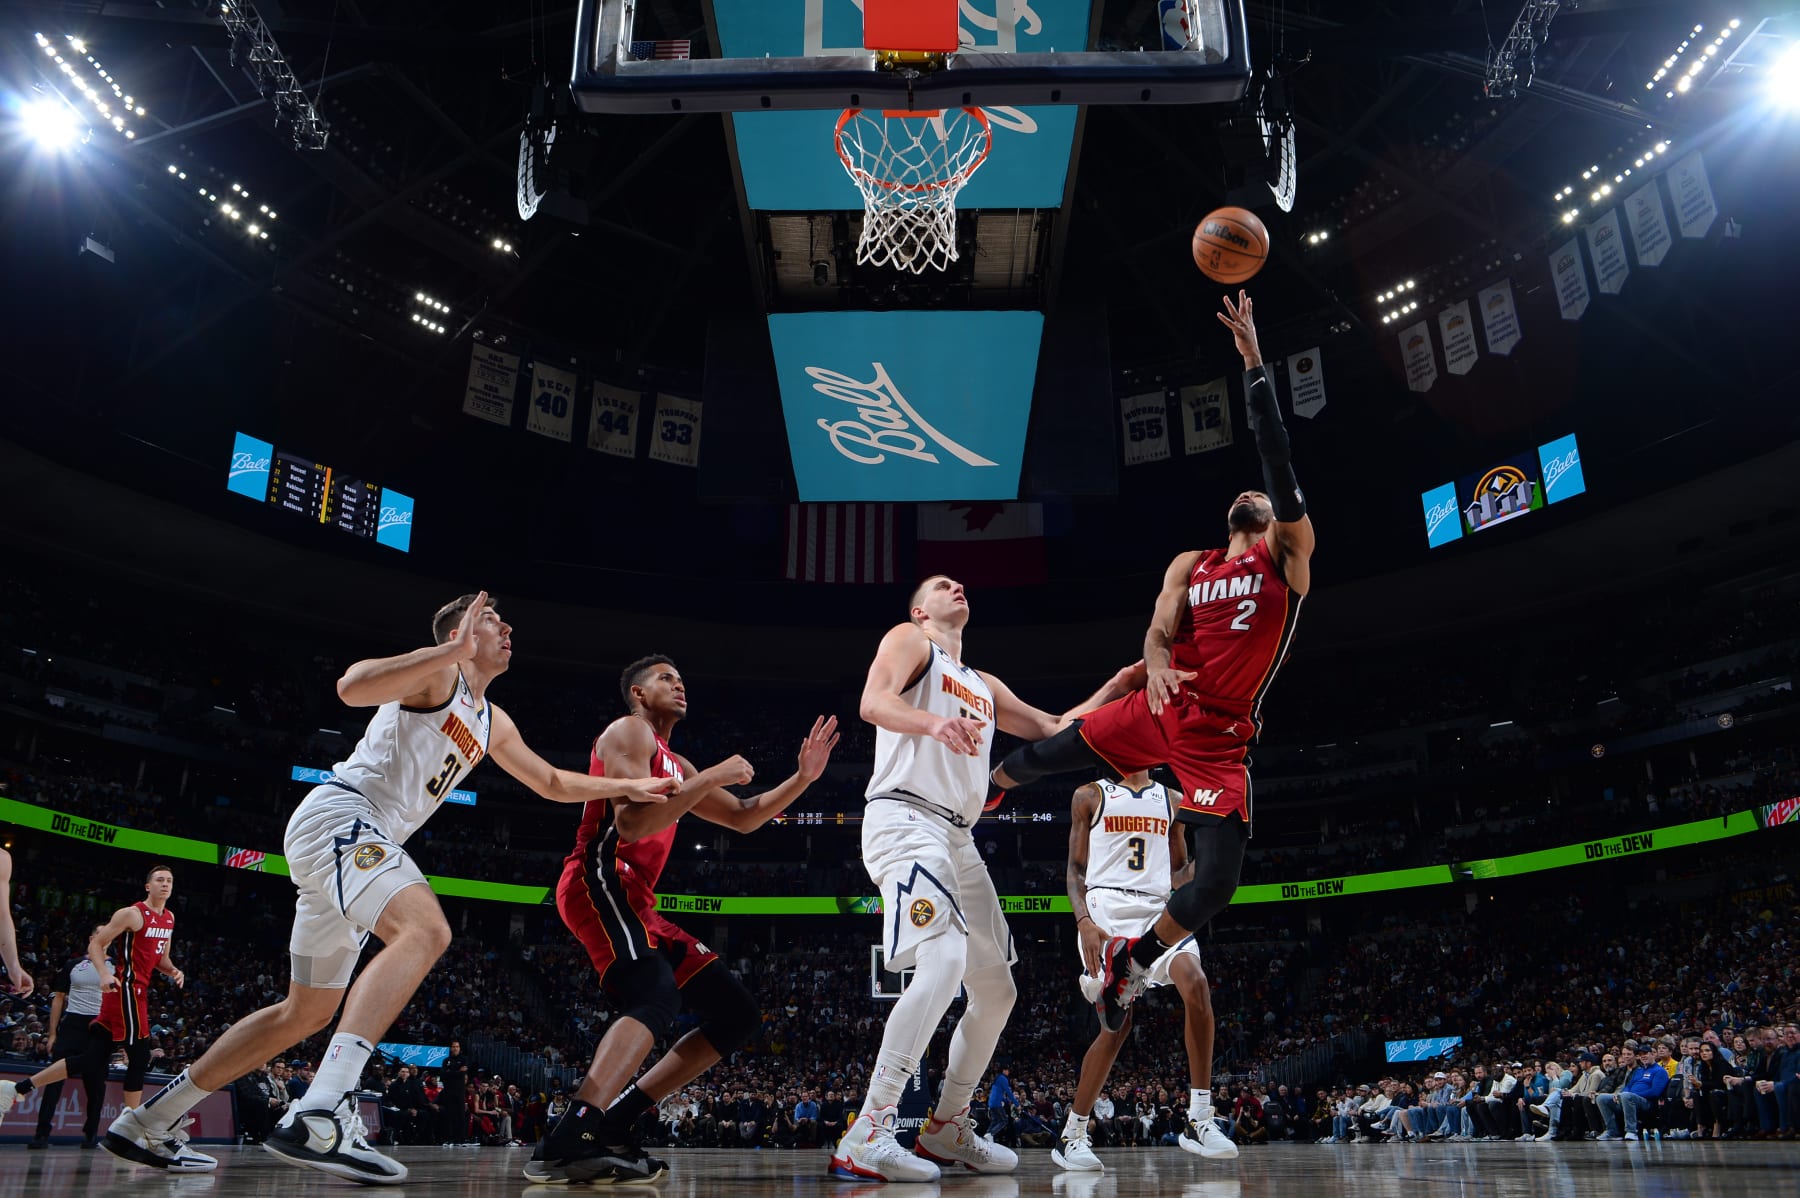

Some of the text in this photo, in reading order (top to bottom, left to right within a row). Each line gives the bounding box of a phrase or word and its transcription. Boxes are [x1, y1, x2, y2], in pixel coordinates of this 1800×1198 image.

[1203, 221, 1249, 249] Wilson
[538, 378, 571, 396] BECK
[536, 391, 568, 418] 40
[598, 397, 634, 414] ISSEL
[804, 362, 999, 466] Ball
[598, 410, 629, 435] 44
[1129, 417, 1163, 442] 55
[1194, 407, 1221, 432] 12
[661, 420, 692, 445] 33
[232, 452, 270, 475] Ball
[1544, 449, 1580, 489] Ball
[380, 507, 411, 528] Ball
[1426, 497, 1458, 532] Ball
[1188, 573, 1264, 607] MIAMI
[1230, 599, 1257, 631] 2
[942, 673, 993, 721] NUGGETS
[426, 753, 462, 802] 31
[446, 792, 471, 803] RENA
[51, 813, 118, 844] DO THE DEW
[1032, 813, 1052, 822] 2:46
[1103, 815, 1168, 837] NUGGETS
[1127, 836, 1146, 872] 3
[1584, 833, 1653, 859] DO THE DEW
[1281, 880, 1344, 898] DO THE DEW
[661, 896, 722, 911] DO THE DEW
[999, 898, 1052, 910] O THE DEW
[155, 940, 168, 954] 5
[402, 1045, 422, 1060] Ball
[427, 1048, 447, 1063] Ball
[1389, 1040, 1408, 1059] Ball
[1414, 1039, 1433, 1057] Ball
